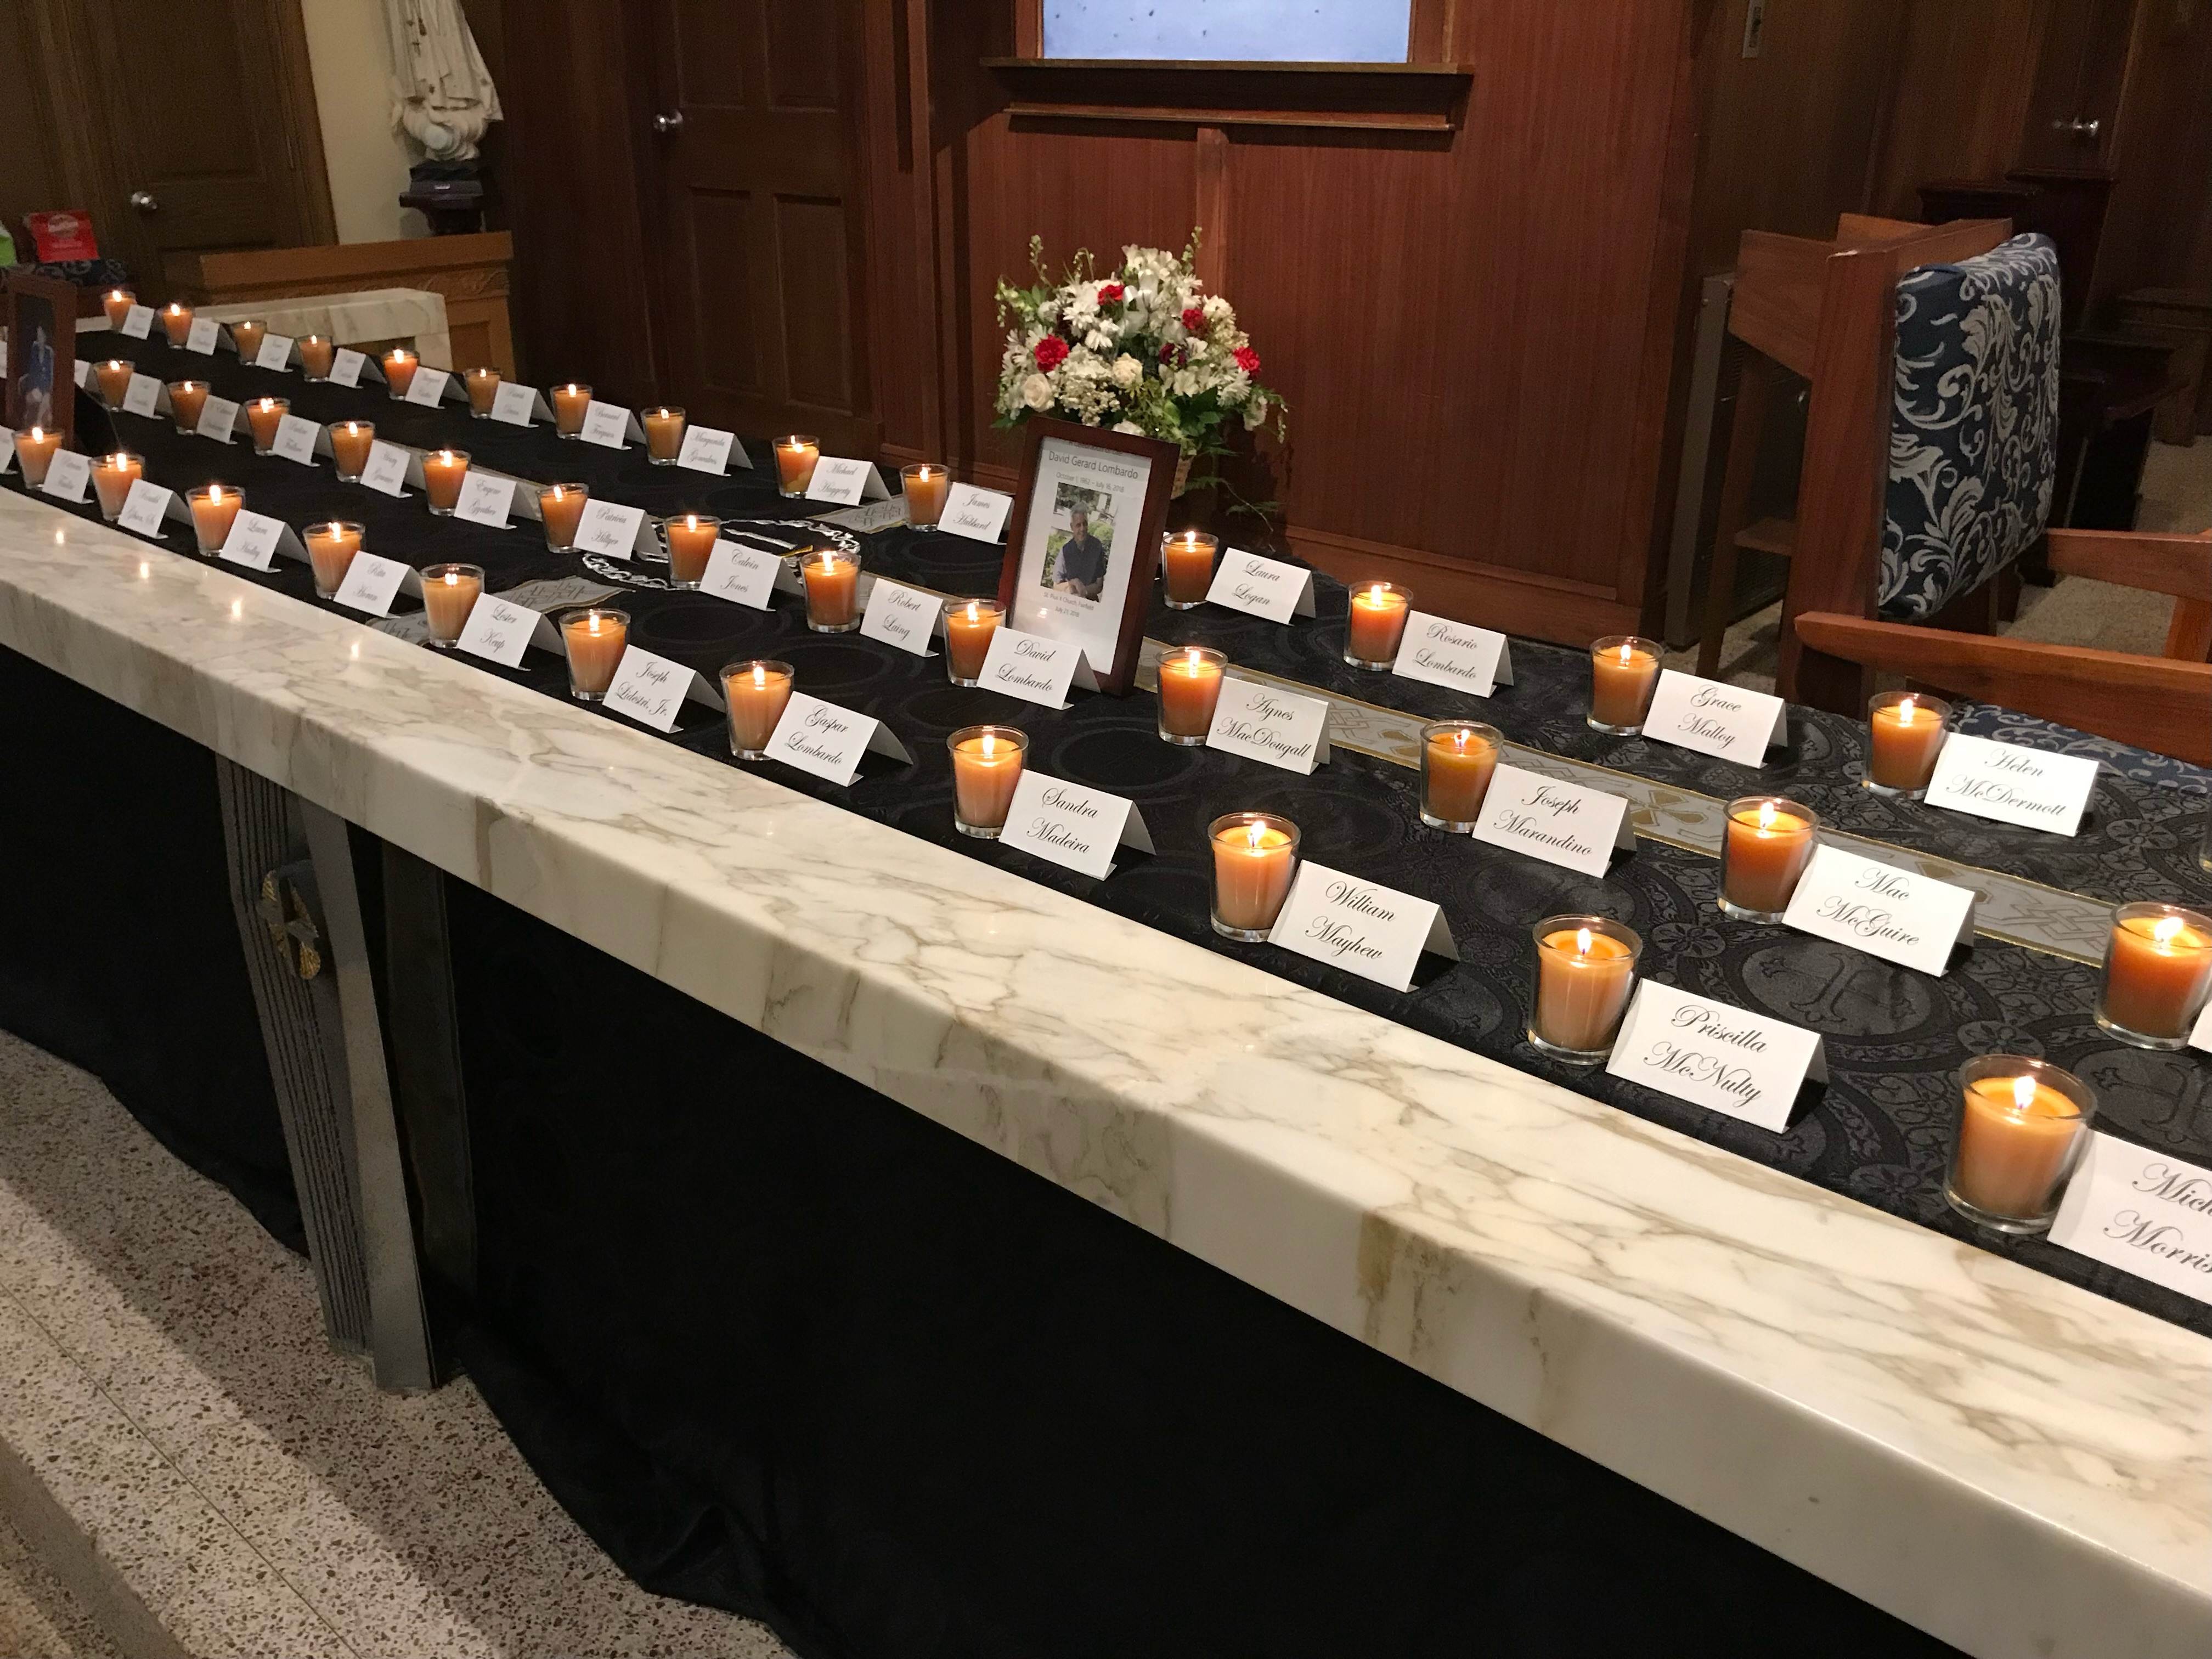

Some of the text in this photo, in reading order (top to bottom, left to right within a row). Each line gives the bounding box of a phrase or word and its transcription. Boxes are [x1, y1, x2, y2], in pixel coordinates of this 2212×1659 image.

[1049, 451, 1138, 479] David Gerard Lombardo
[1056, 472, 1075, 481] October
[1113, 484, 1125, 493] 2018
[596, 506, 627, 523] Patricia
[962, 493, 991, 509] James
[953, 510, 992, 531] Hubbard
[731, 549, 759, 570] Calvin
[1243, 560, 1280, 582] Laura
[720, 575, 749, 592] Jones
[1232, 583, 1271, 607] Logan
[490, 604, 517, 624] Lester
[888, 589, 922, 611] Robert
[882, 614, 911, 642] Laing
[1426, 623, 1479, 651] Rosario
[1013, 640, 1056, 663] David
[1413, 648, 1477, 680] Lombardo
[636, 662, 670, 686] Joseph
[995, 663, 1053, 692] Lombardo
[648, 699, 672, 716] Jr.
[1246, 693, 1295, 722] Agnes
[1691, 684, 1741, 713] Grace
[804, 705, 849, 734] Gaspar
[1678, 713, 1736, 749] Malloy
[785, 731, 843, 766] Lombardo
[1216, 717, 1312, 759] MacDougall
[1984, 748, 2045, 777] Helen
[1041, 787, 1098, 819] Sandra
[1522, 786, 1581, 815] Joseph
[1945, 774, 2067, 816] McDermott
[1026, 817, 1090, 854] Madeira
[1493, 809, 1593, 856] Marandino
[1325, 881, 1396, 923] William
[1816, 895, 1920, 946] McGuire
[1305, 916, 1384, 961] Mayhew
[1671, 1005, 1768, 1054] Priscilla
[1643, 1041, 1762, 1108] McNulty
